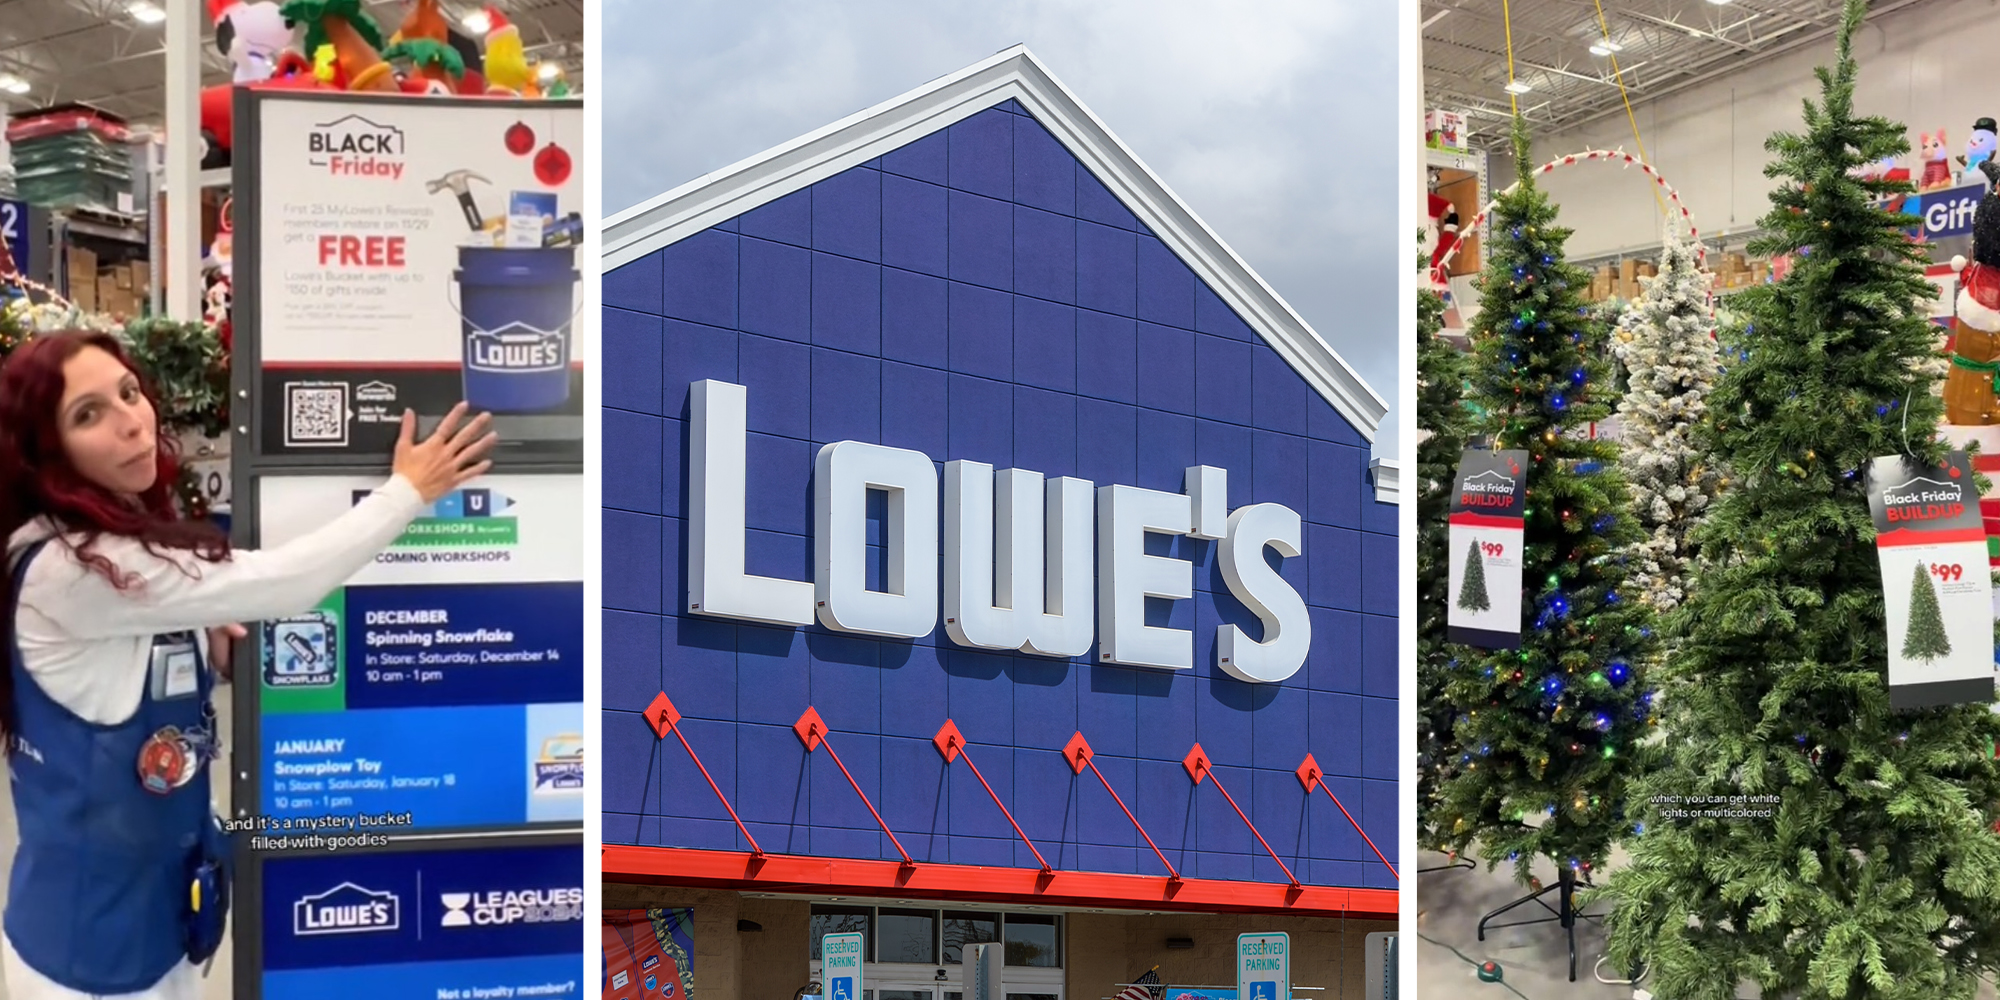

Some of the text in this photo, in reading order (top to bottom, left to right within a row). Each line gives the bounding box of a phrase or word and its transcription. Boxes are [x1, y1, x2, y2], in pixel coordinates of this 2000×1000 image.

[310, 133, 392, 154] BLACK
[331, 156, 404, 180] Friday
[1456, 158, 1464, 168] 21
[284, 204, 434, 216] First 25 MyLowe's Rewards
[1926, 198, 1978, 232] Gift
[284, 220, 430, 230] members instore on 11/29
[284, 233, 315, 244] get a
[319, 235, 406, 266] FREE
[284, 271, 424, 284] Lowe's Bucket with up to
[311, 285, 323, 296] of
[325, 286, 352, 297] gifts
[475, 339, 559, 366] LOWE'S
[1462, 482, 1514, 495] Black Friday
[1461, 493, 1514, 507] BUILDUP
[1884, 491, 1962, 505] Black Friday
[1886, 504, 1964, 522] BUILDUP
[402, 523, 474, 534] ORKSHOPS
[688, 379, 1311, 684] LOWE'S
[1482, 541, 1504, 556] $99
[431, 551, 510, 562] WORKSHOPS
[1931, 562, 1962, 582] $99
[366, 610, 448, 624] DECEMBER
[366, 628, 514, 647] Spinning Snowflake
[366, 650, 560, 665] In Store: Saturday, December 14
[366, 670, 380, 682] 10
[382, 672, 404, 682] am
[414, 670, 420, 680] 1
[422, 670, 443, 683] pm
[274, 739, 345, 754] JANUARY
[274, 758, 382, 776] Snowplow Toy
[274, 774, 456, 792] In Store: Saturday, January 18
[275, 798, 288, 808] 10
[290, 798, 312, 808] am
[324, 796, 328, 806] 1
[331, 796, 352, 808] pm
[473, 887, 583, 908] LEAGUES
[306, 901, 388, 928] LOWE'S
[473, 907, 524, 925] CUP
[826, 942, 860, 954] RESERVED
[1242, 942, 1284, 956] RESERVED
[828, 956, 856, 968] PARKING
[1246, 958, 1280, 971] PARKING
[437, 980, 576, 1000] Not a loyalty member?
